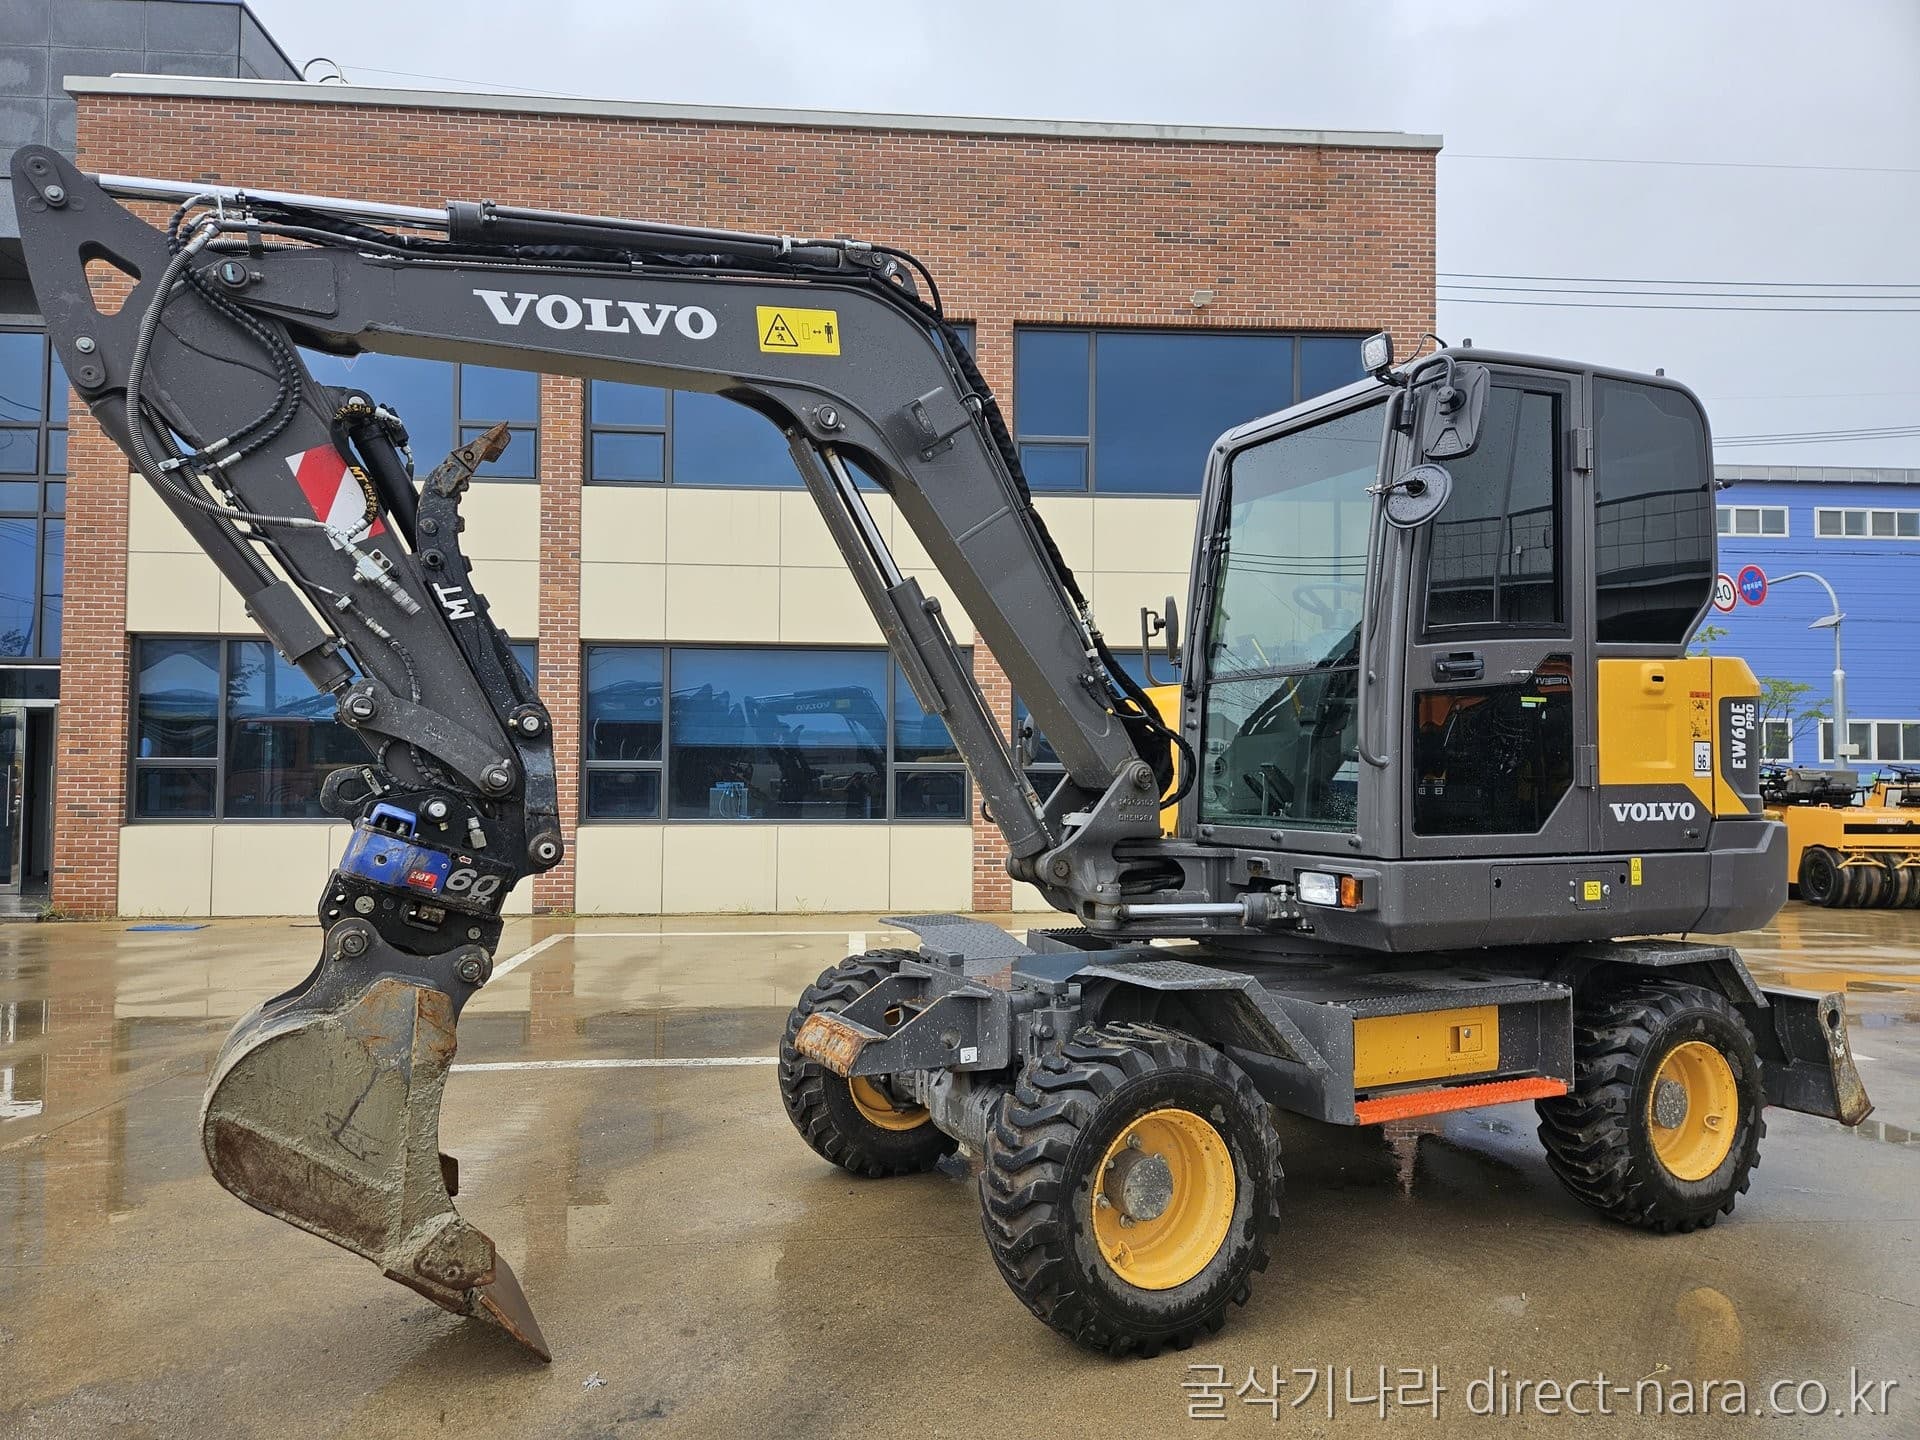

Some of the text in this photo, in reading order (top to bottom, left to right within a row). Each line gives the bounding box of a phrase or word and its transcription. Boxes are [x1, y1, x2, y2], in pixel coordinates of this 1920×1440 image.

[473, 289, 717, 340] VOLVO
[432, 583, 475, 620] MT
[1714, 585, 1731, 601] 40
[1746, 704, 1755, 729] PRO
[1731, 703, 1746, 768] EW60E
[1697, 754, 1707, 768] 96
[1609, 802, 1696, 822] VOLVO
[446, 868, 500, 897] 60
